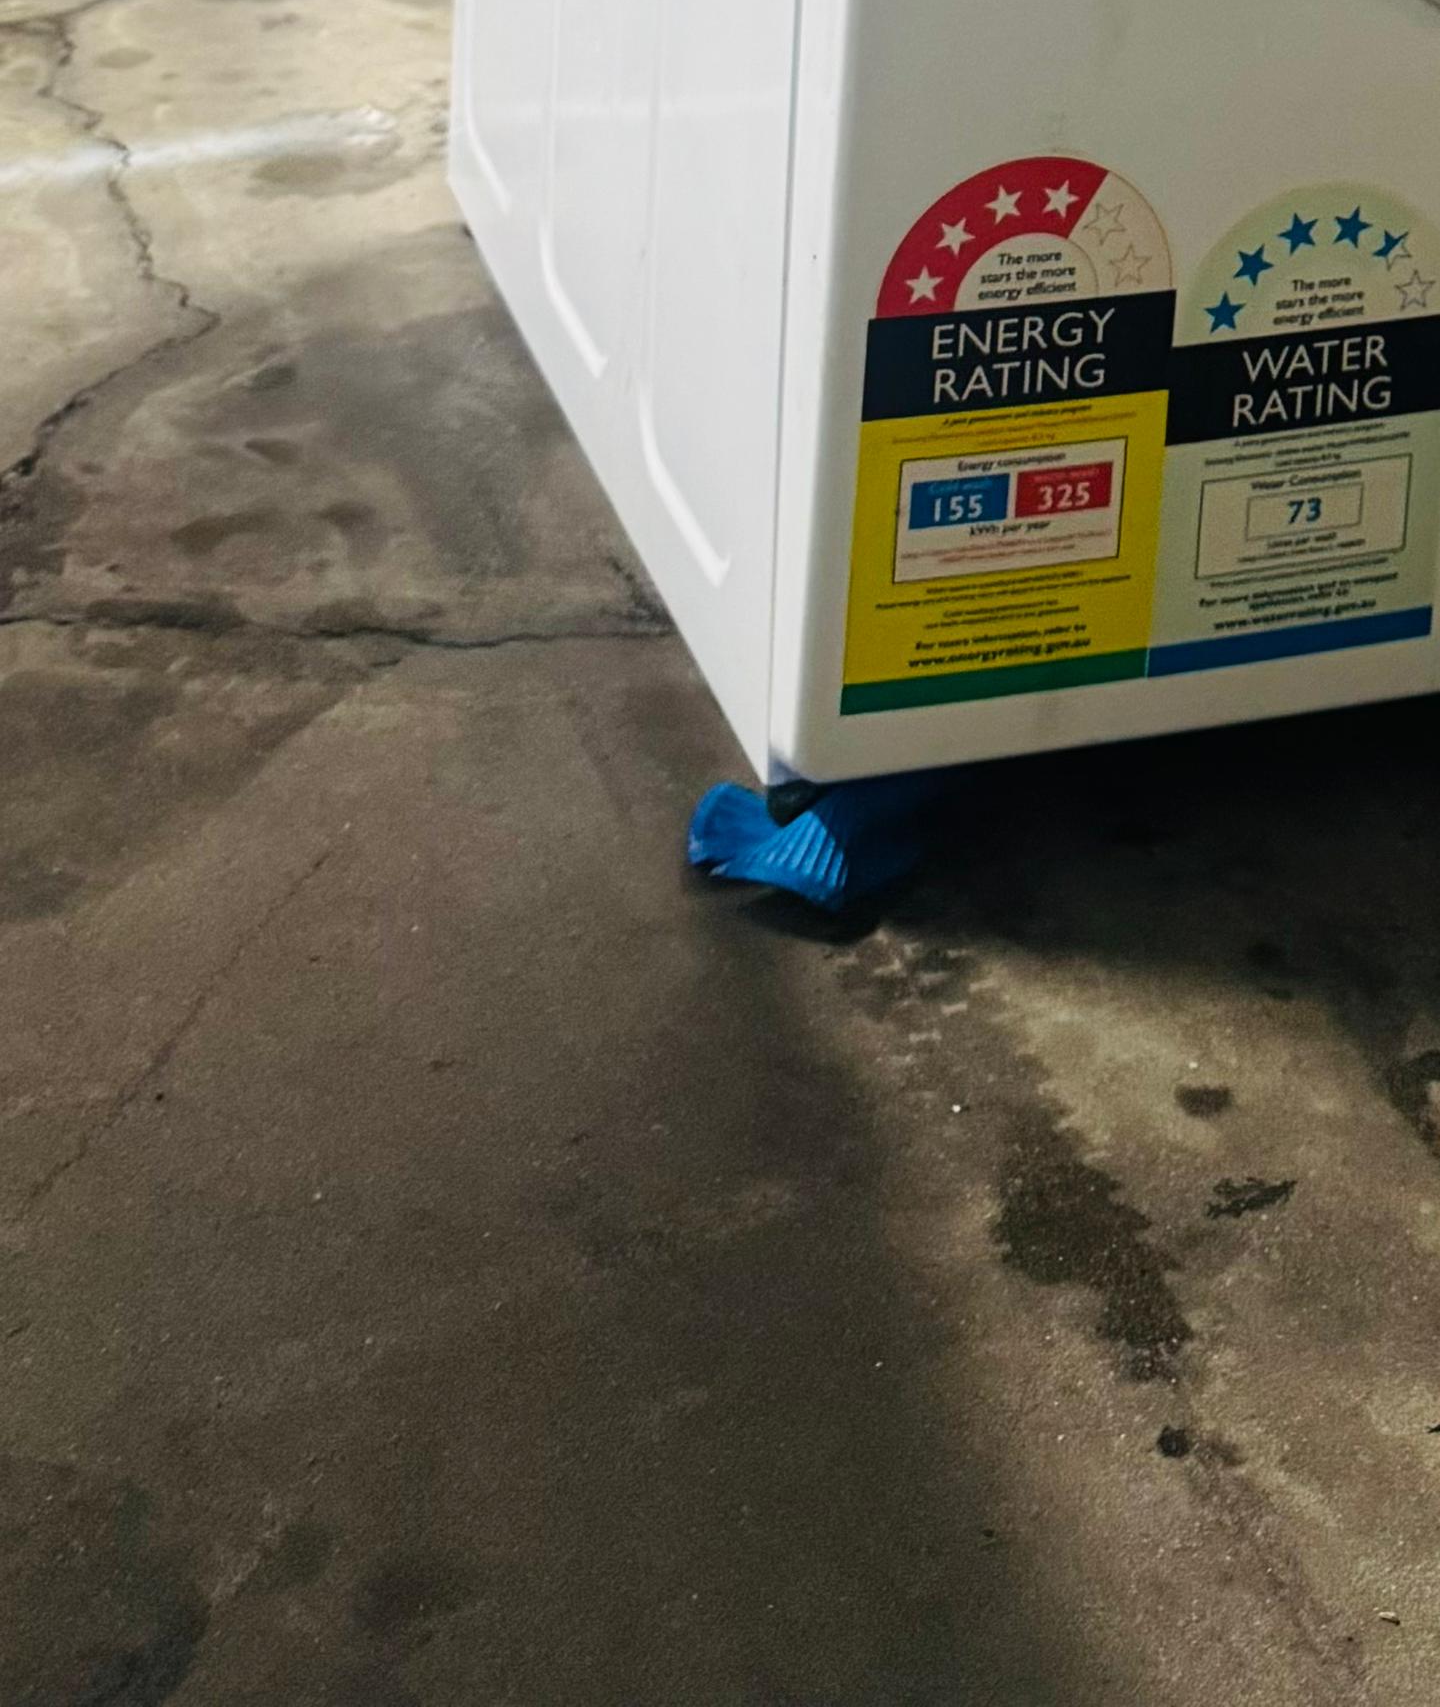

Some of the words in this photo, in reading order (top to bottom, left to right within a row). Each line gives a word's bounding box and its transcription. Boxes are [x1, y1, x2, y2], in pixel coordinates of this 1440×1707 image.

[998, 253, 1023, 265] The
[1026, 252, 1062, 263] more
[980, 272, 1011, 284] stars
[1015, 269, 1037, 281] the
[1041, 267, 1076, 277] more
[1292, 279, 1315, 291] The
[1318, 277, 1352, 288] more
[978, 288, 1022, 300] energy
[1026, 281, 1076, 295] efficient
[1276, 298, 1304, 310] stars
[1308, 294, 1328, 305] the
[1331, 291, 1364, 302] more
[1273, 313, 1313, 325] energy
[1318, 306, 1364, 319] efficient
[931, 307, 1115, 360] ENERGY
[1242, 335, 1388, 383] WATER
[933, 353, 1106, 404] RATING
[1232, 375, 1392, 427] RATING
[957, 457, 994, 472] Energy
[934, 493, 984, 523] 155
[1036, 481, 1091, 513] 325
[1287, 497, 1321, 525] 73
